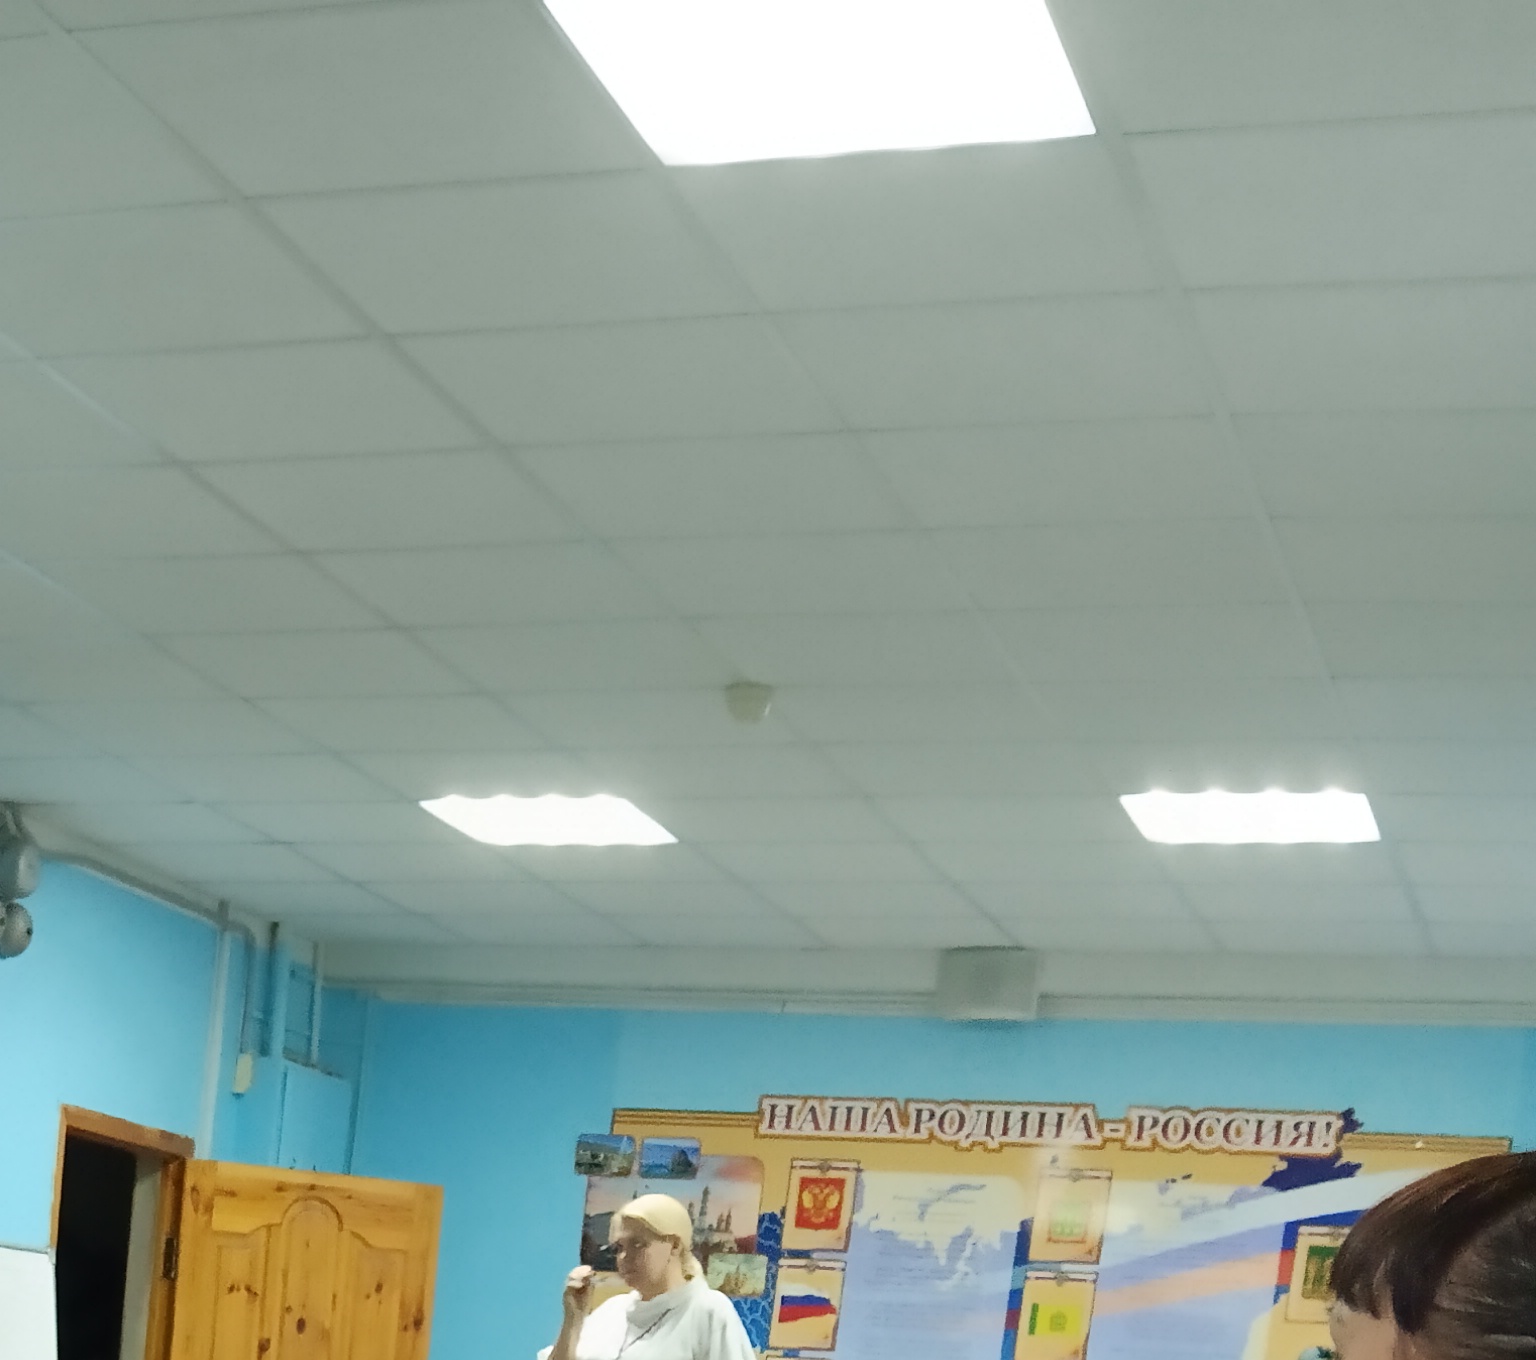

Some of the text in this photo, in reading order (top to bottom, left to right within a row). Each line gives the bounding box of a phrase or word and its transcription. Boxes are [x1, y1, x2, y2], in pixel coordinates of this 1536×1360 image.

[766, 1102, 897, 1135] НАША
[913, 1106, 1093, 1144] РОДИНА
[1135, 1113, 1334, 1149] РОССИЯ!
